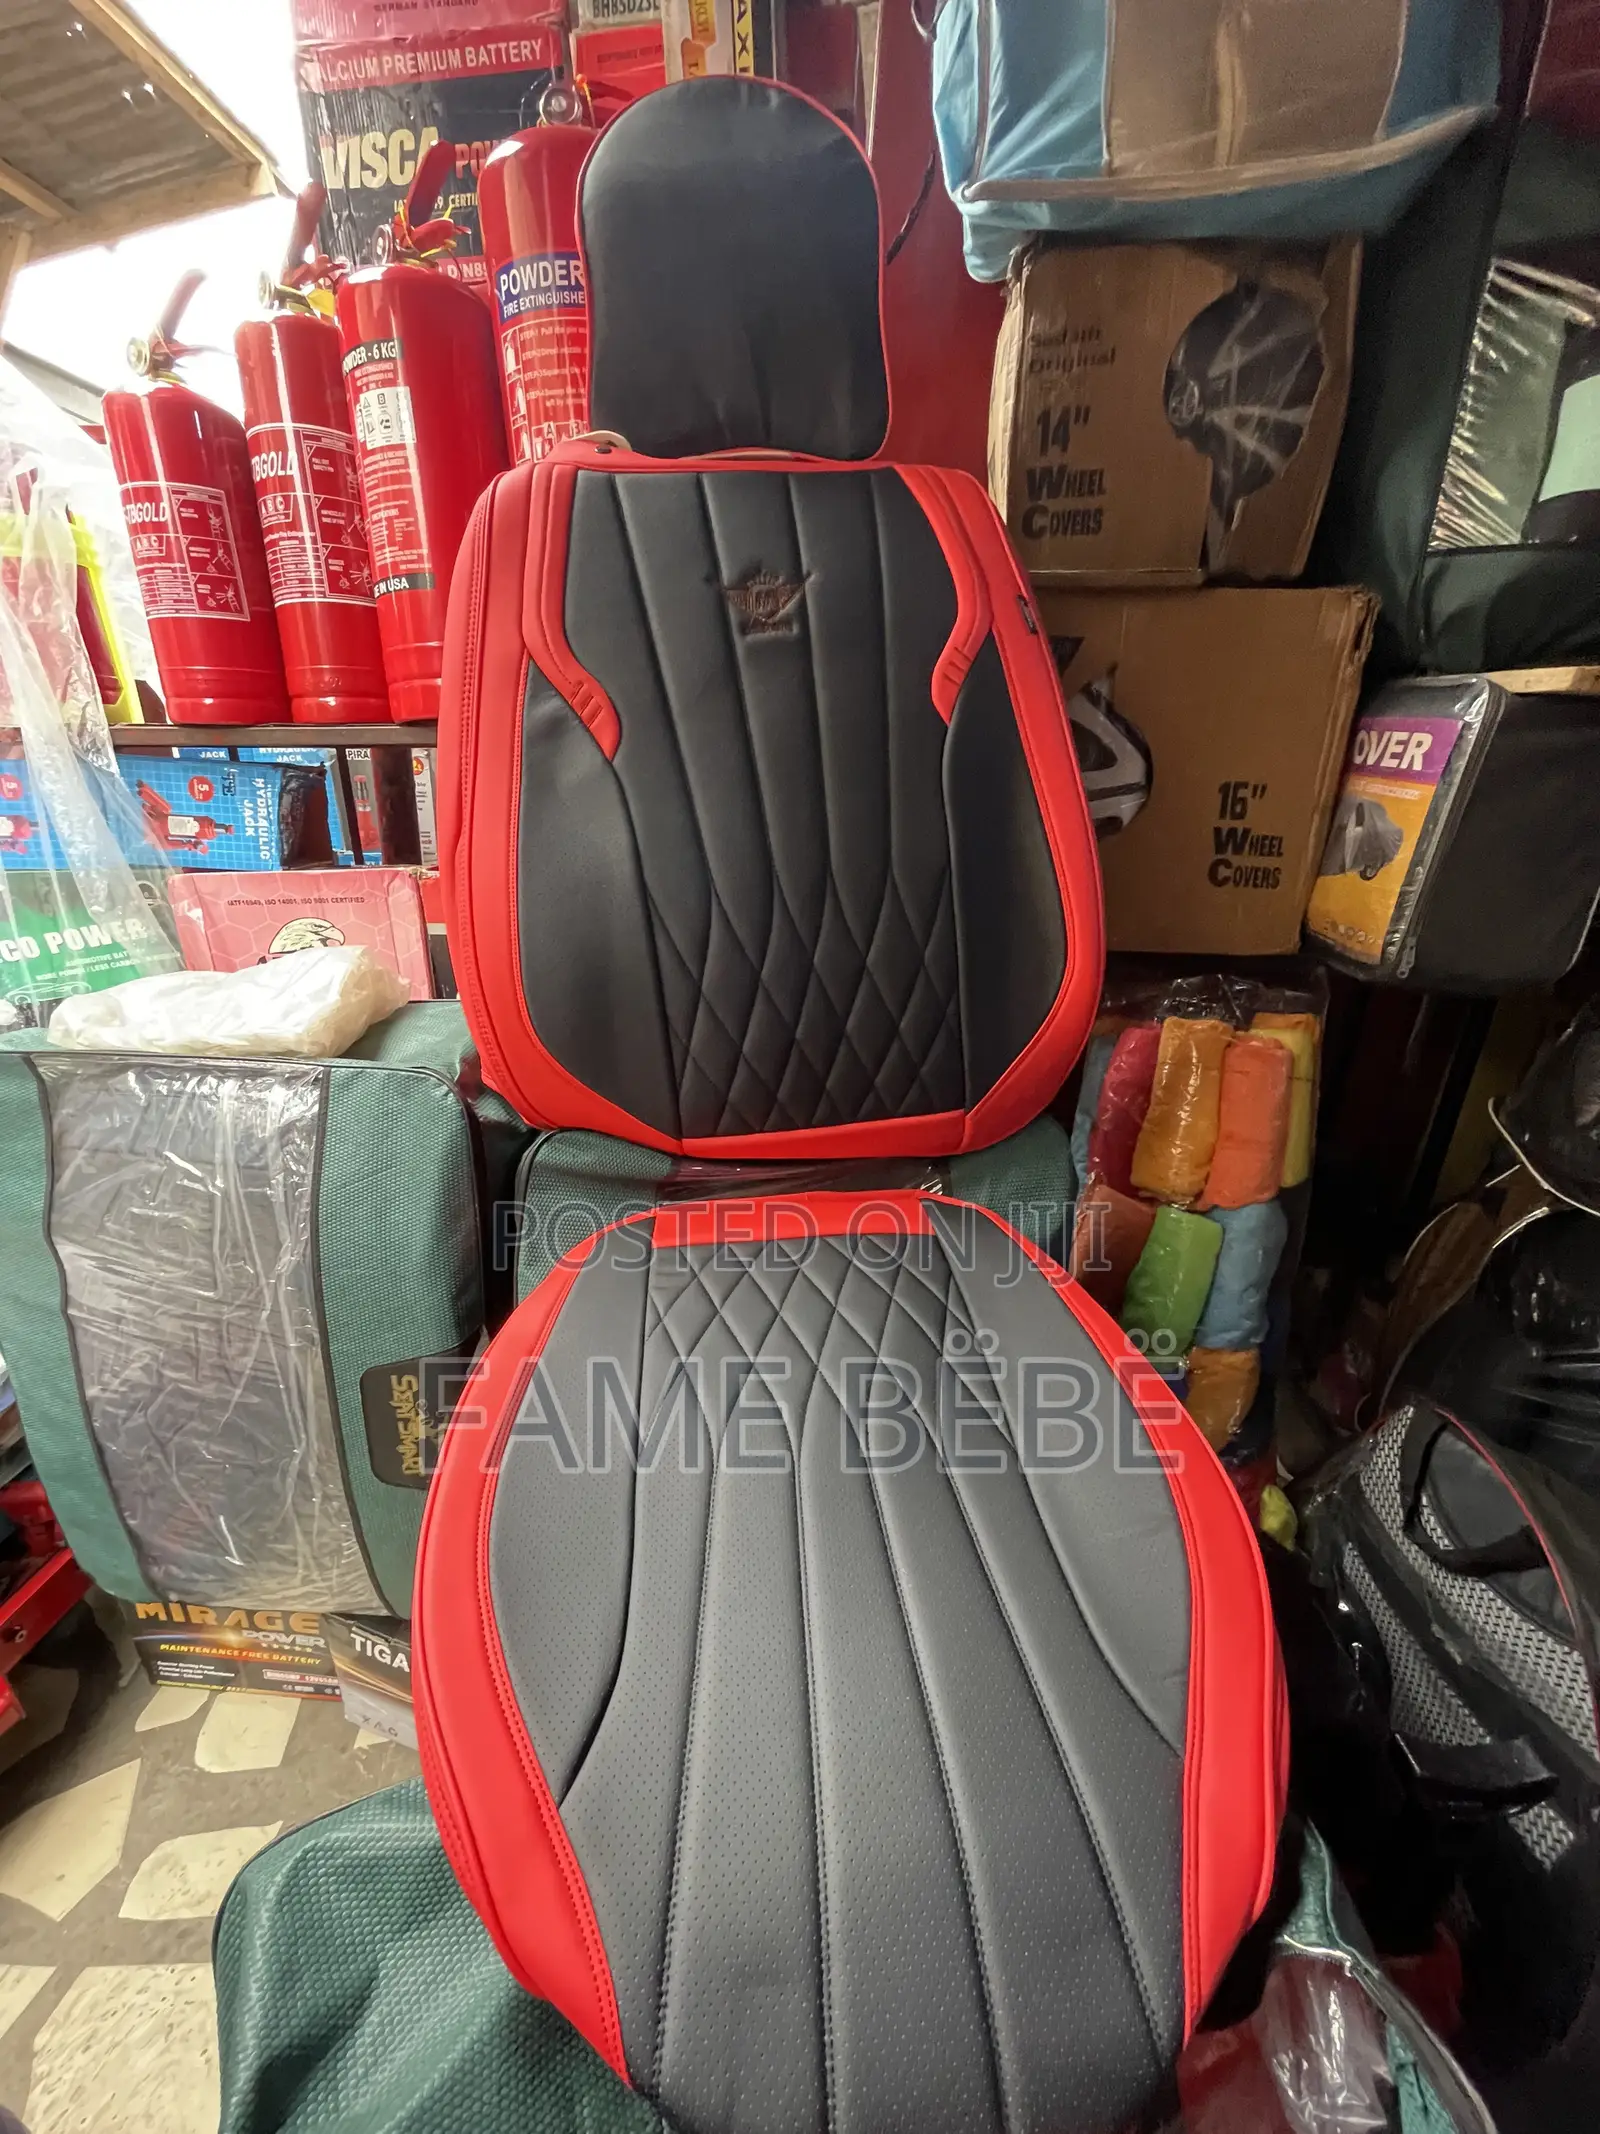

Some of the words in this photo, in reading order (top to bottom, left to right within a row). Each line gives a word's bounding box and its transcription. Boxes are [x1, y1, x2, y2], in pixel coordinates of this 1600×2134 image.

[314, 57, 380, 83] ALCIUM
[383, 48, 461, 77] PREMIUM
[465, 38, 543, 67] BATTERY
[500, 260, 585, 301] POWDER
[503, 302, 519, 318] FIRE
[373, 344, 380, 359] 6
[381, 341, 396, 358] KG
[1036, 406, 1092, 457] 14"
[200, 751, 226, 759] JACK
[277, 754, 303, 762] JACK
[1353, 730, 1433, 771] OVER
[243, 799, 255, 837] JACK
[252, 778, 271, 860] HYDRAULIC
[330, 896, 365, 904] CERTIFIED
[0, 936, 41, 963] CO
[43, 918, 148, 955] POWER
[389, 1374, 419, 1418] SEAT
[396, 1420, 425, 1477] SMART
[136, 1602, 321, 1635] MIRAGE
[160, 1644, 239, 1657] MAINTENANCE
[242, 1649, 270, 1660] FREE
[272, 1653, 321, 1665] BATTERY
[242, 1629, 327, 1648] POWER
[350, 1633, 410, 1673] TIGA
